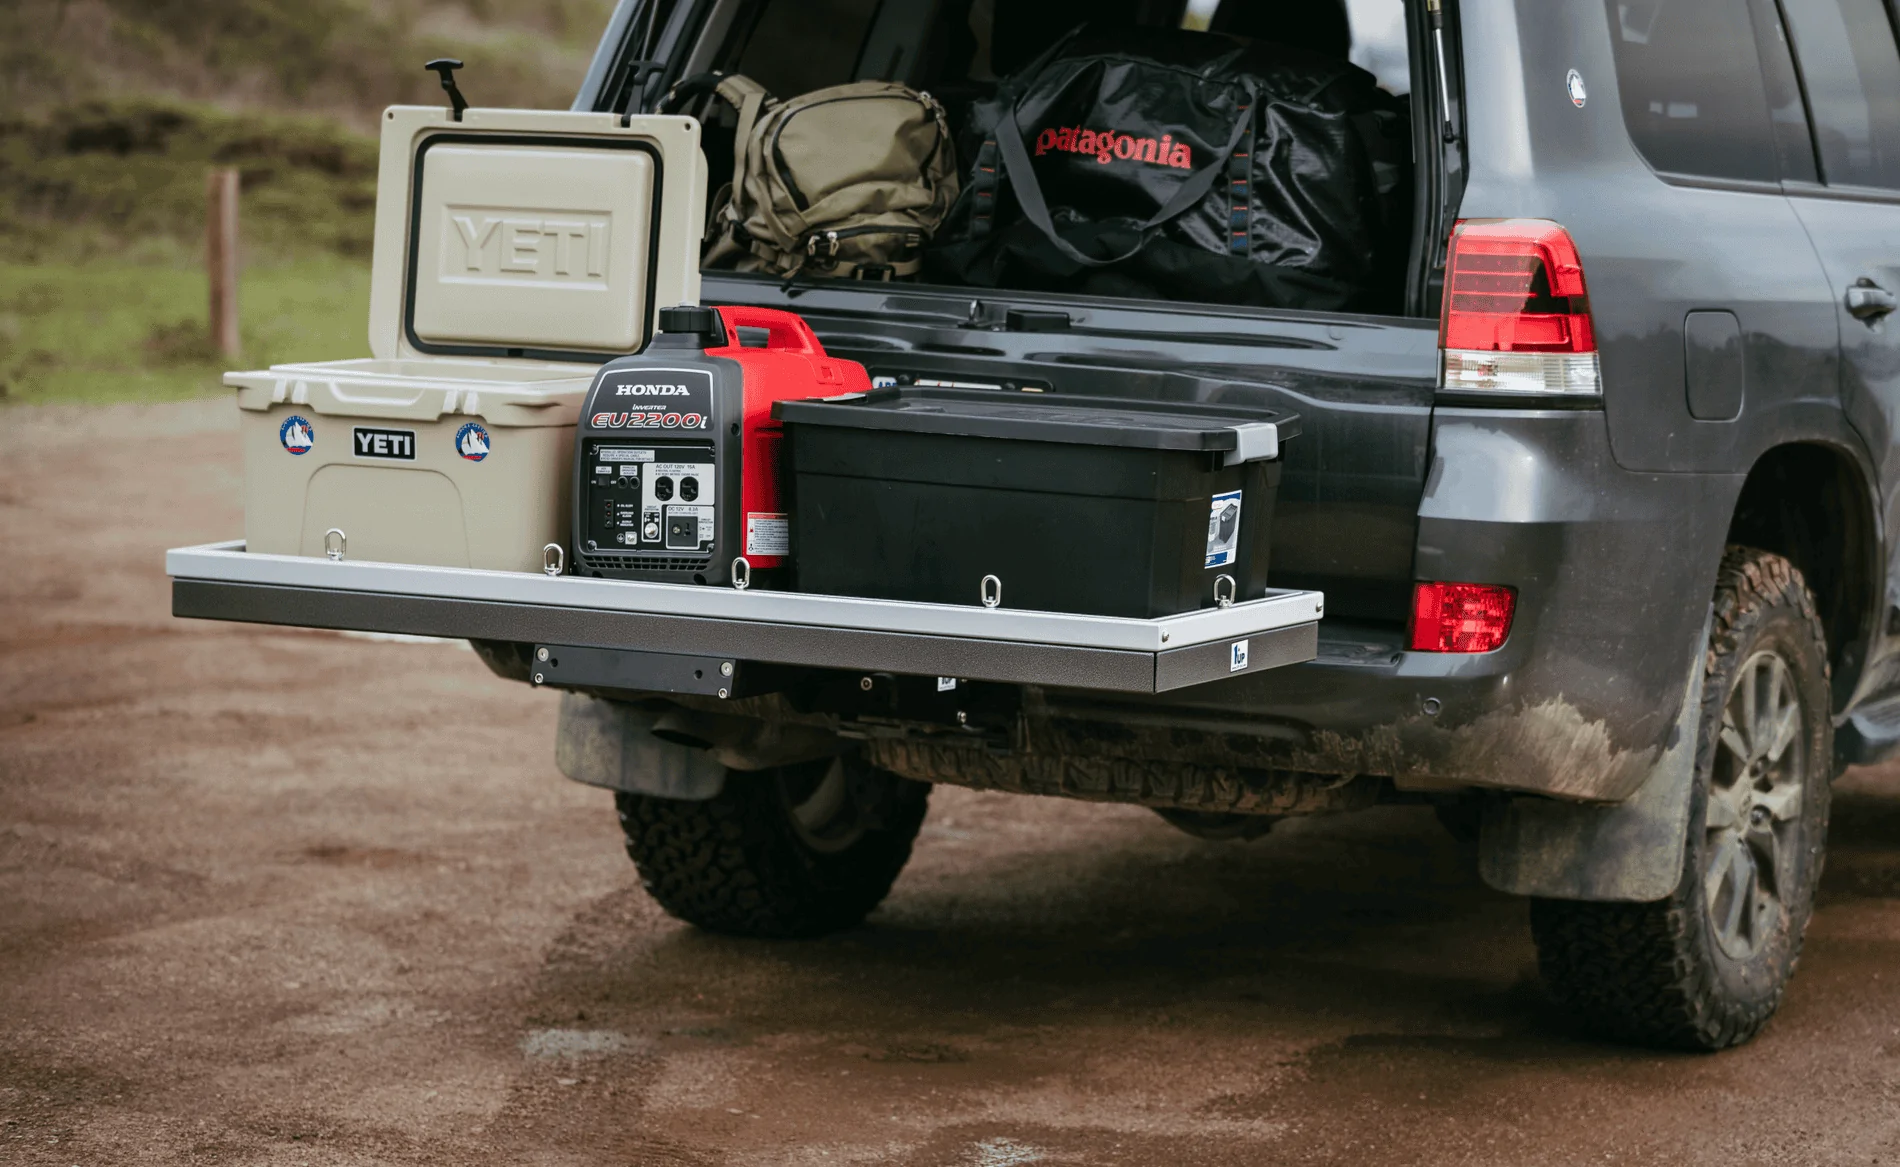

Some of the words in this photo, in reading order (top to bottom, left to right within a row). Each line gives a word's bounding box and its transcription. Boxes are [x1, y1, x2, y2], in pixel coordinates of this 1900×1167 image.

[1035, 125, 1192, 169] patagonia
[453, 216, 607, 277] YETI
[615, 384, 690, 396] HONDA
[591, 412, 708, 429] EU2200i
[356, 432, 411, 456] YETI
